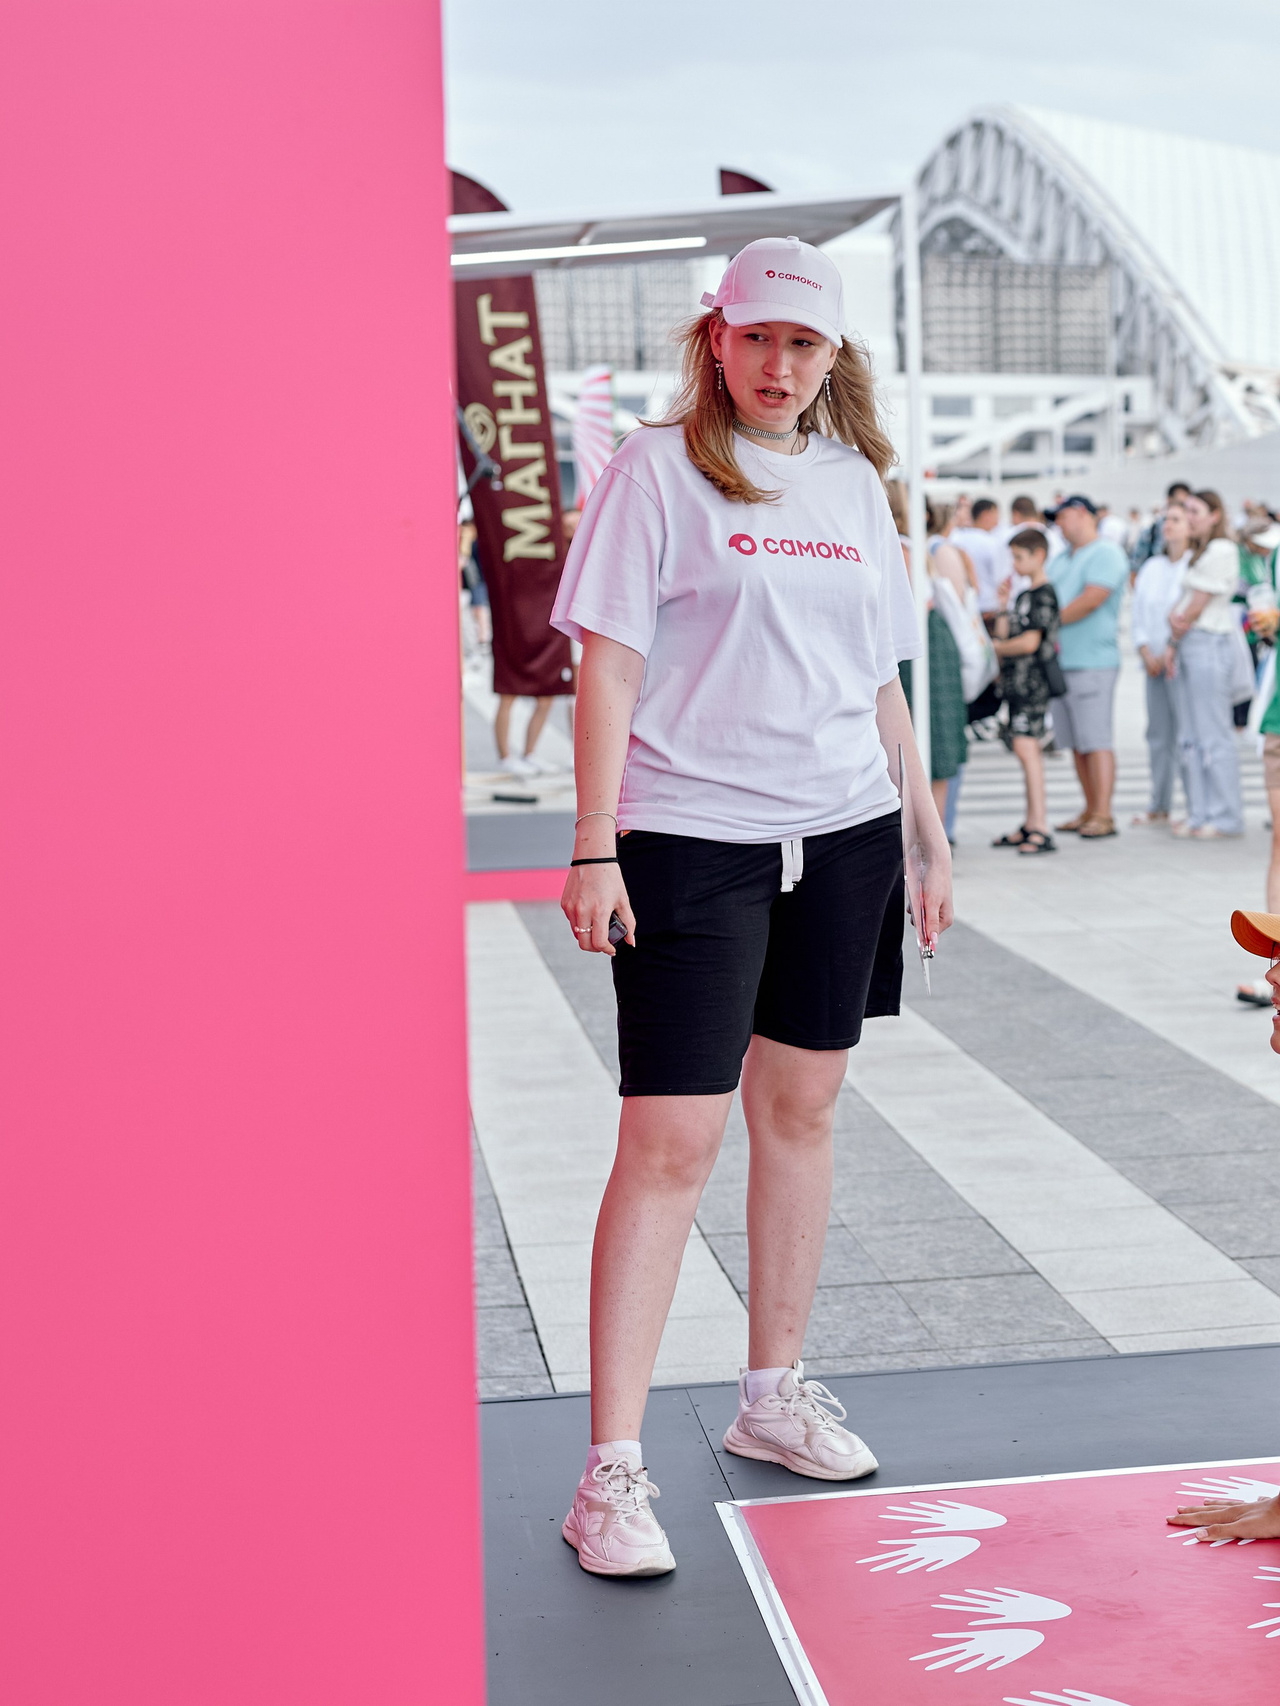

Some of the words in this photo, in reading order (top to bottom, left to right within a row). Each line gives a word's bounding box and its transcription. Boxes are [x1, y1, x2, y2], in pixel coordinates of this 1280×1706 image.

[777, 272, 823, 291] самокат
[477, 293, 556, 562] МАГНАТ
[763, 538, 868, 567] самока
